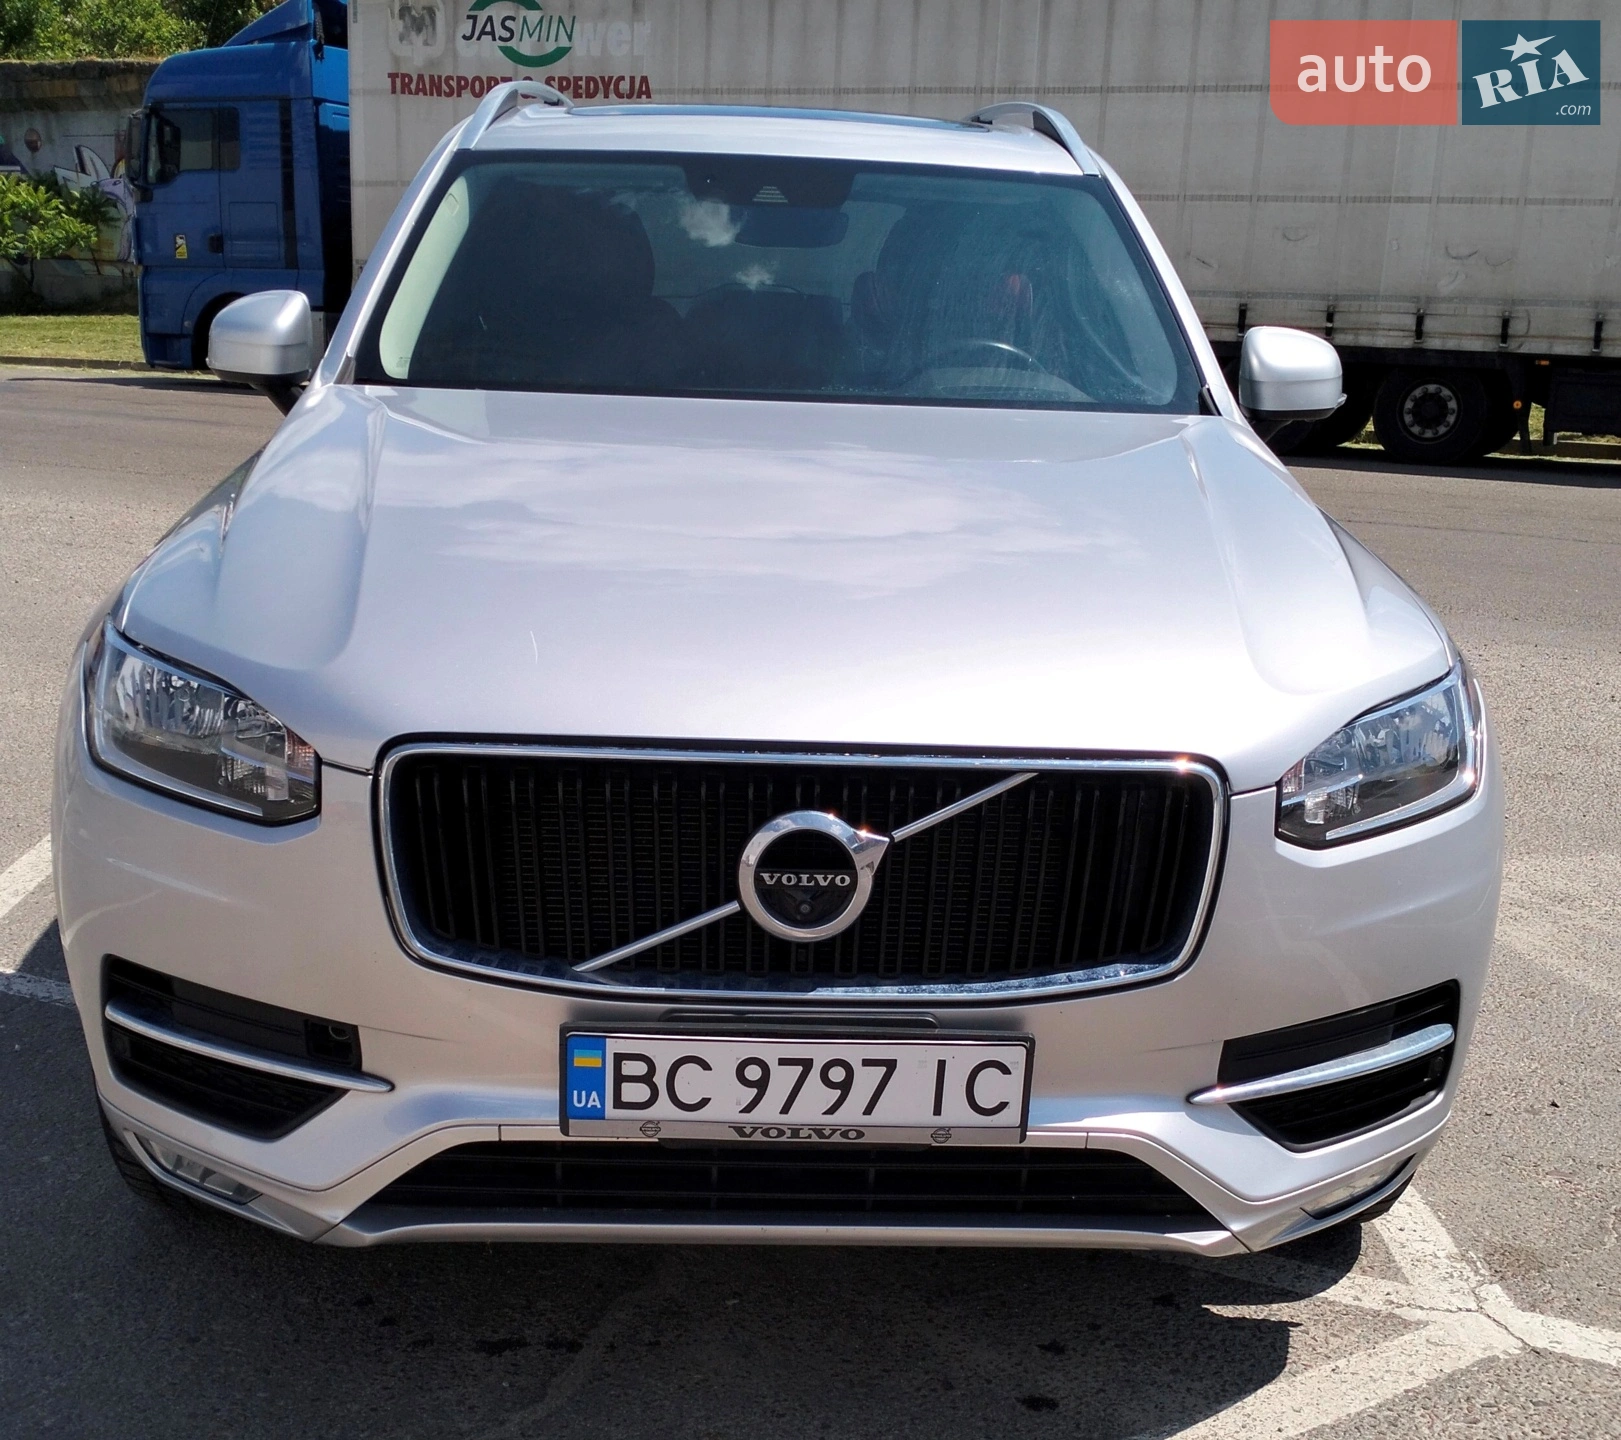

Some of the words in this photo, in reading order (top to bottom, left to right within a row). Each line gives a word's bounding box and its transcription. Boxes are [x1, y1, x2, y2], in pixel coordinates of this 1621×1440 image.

[461, 14, 576, 43] JASMIN
[760, 872, 851, 887] VOLVO
[612, 1051, 713, 1113] BC
[735, 1056, 898, 1115] 9797
[573, 1089, 601, 1108] UA
[728, 1125, 866, 1140] VOLVO
